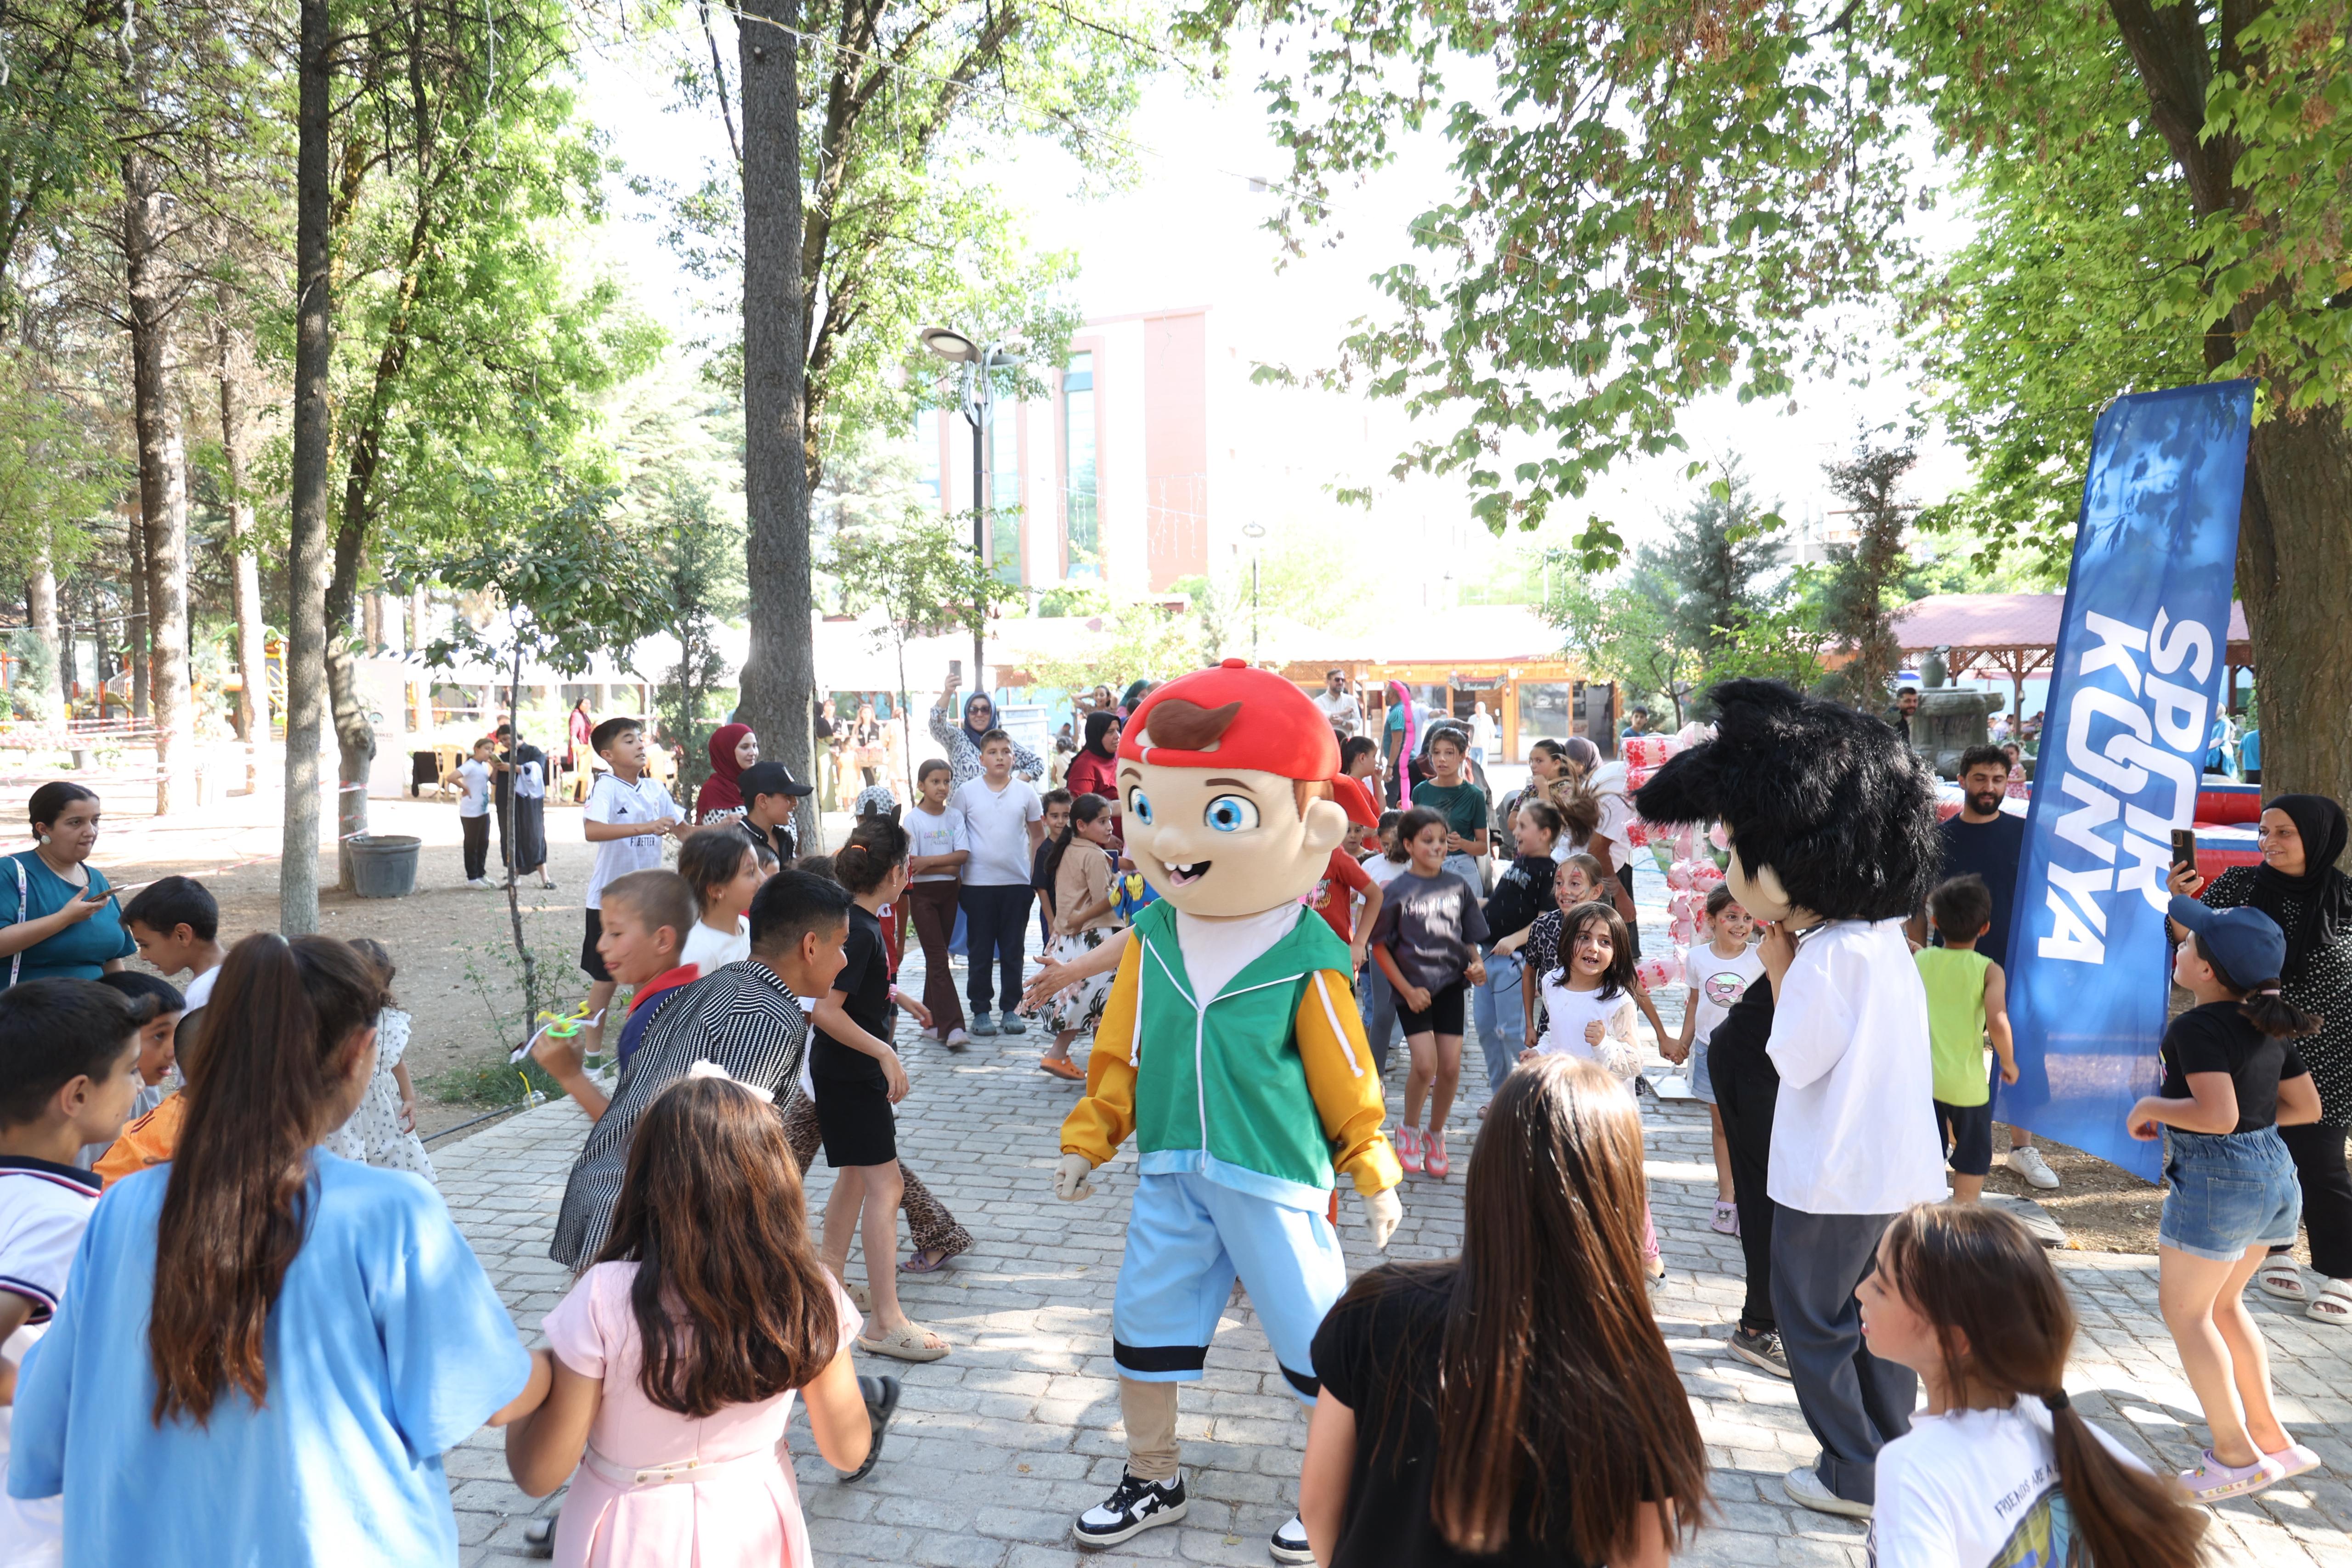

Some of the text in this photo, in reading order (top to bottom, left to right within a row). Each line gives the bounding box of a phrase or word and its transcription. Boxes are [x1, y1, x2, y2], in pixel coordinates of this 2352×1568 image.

[637, 837, 655, 846] BETTER
[2038, 610, 2152, 964] KONYA
[2105, 606, 2213, 914] SPOR
[1994, 1479, 2030, 1521] FRIENDS
[2032, 1467, 2045, 1489] ARE
[2046, 1462, 2053, 1478] A
